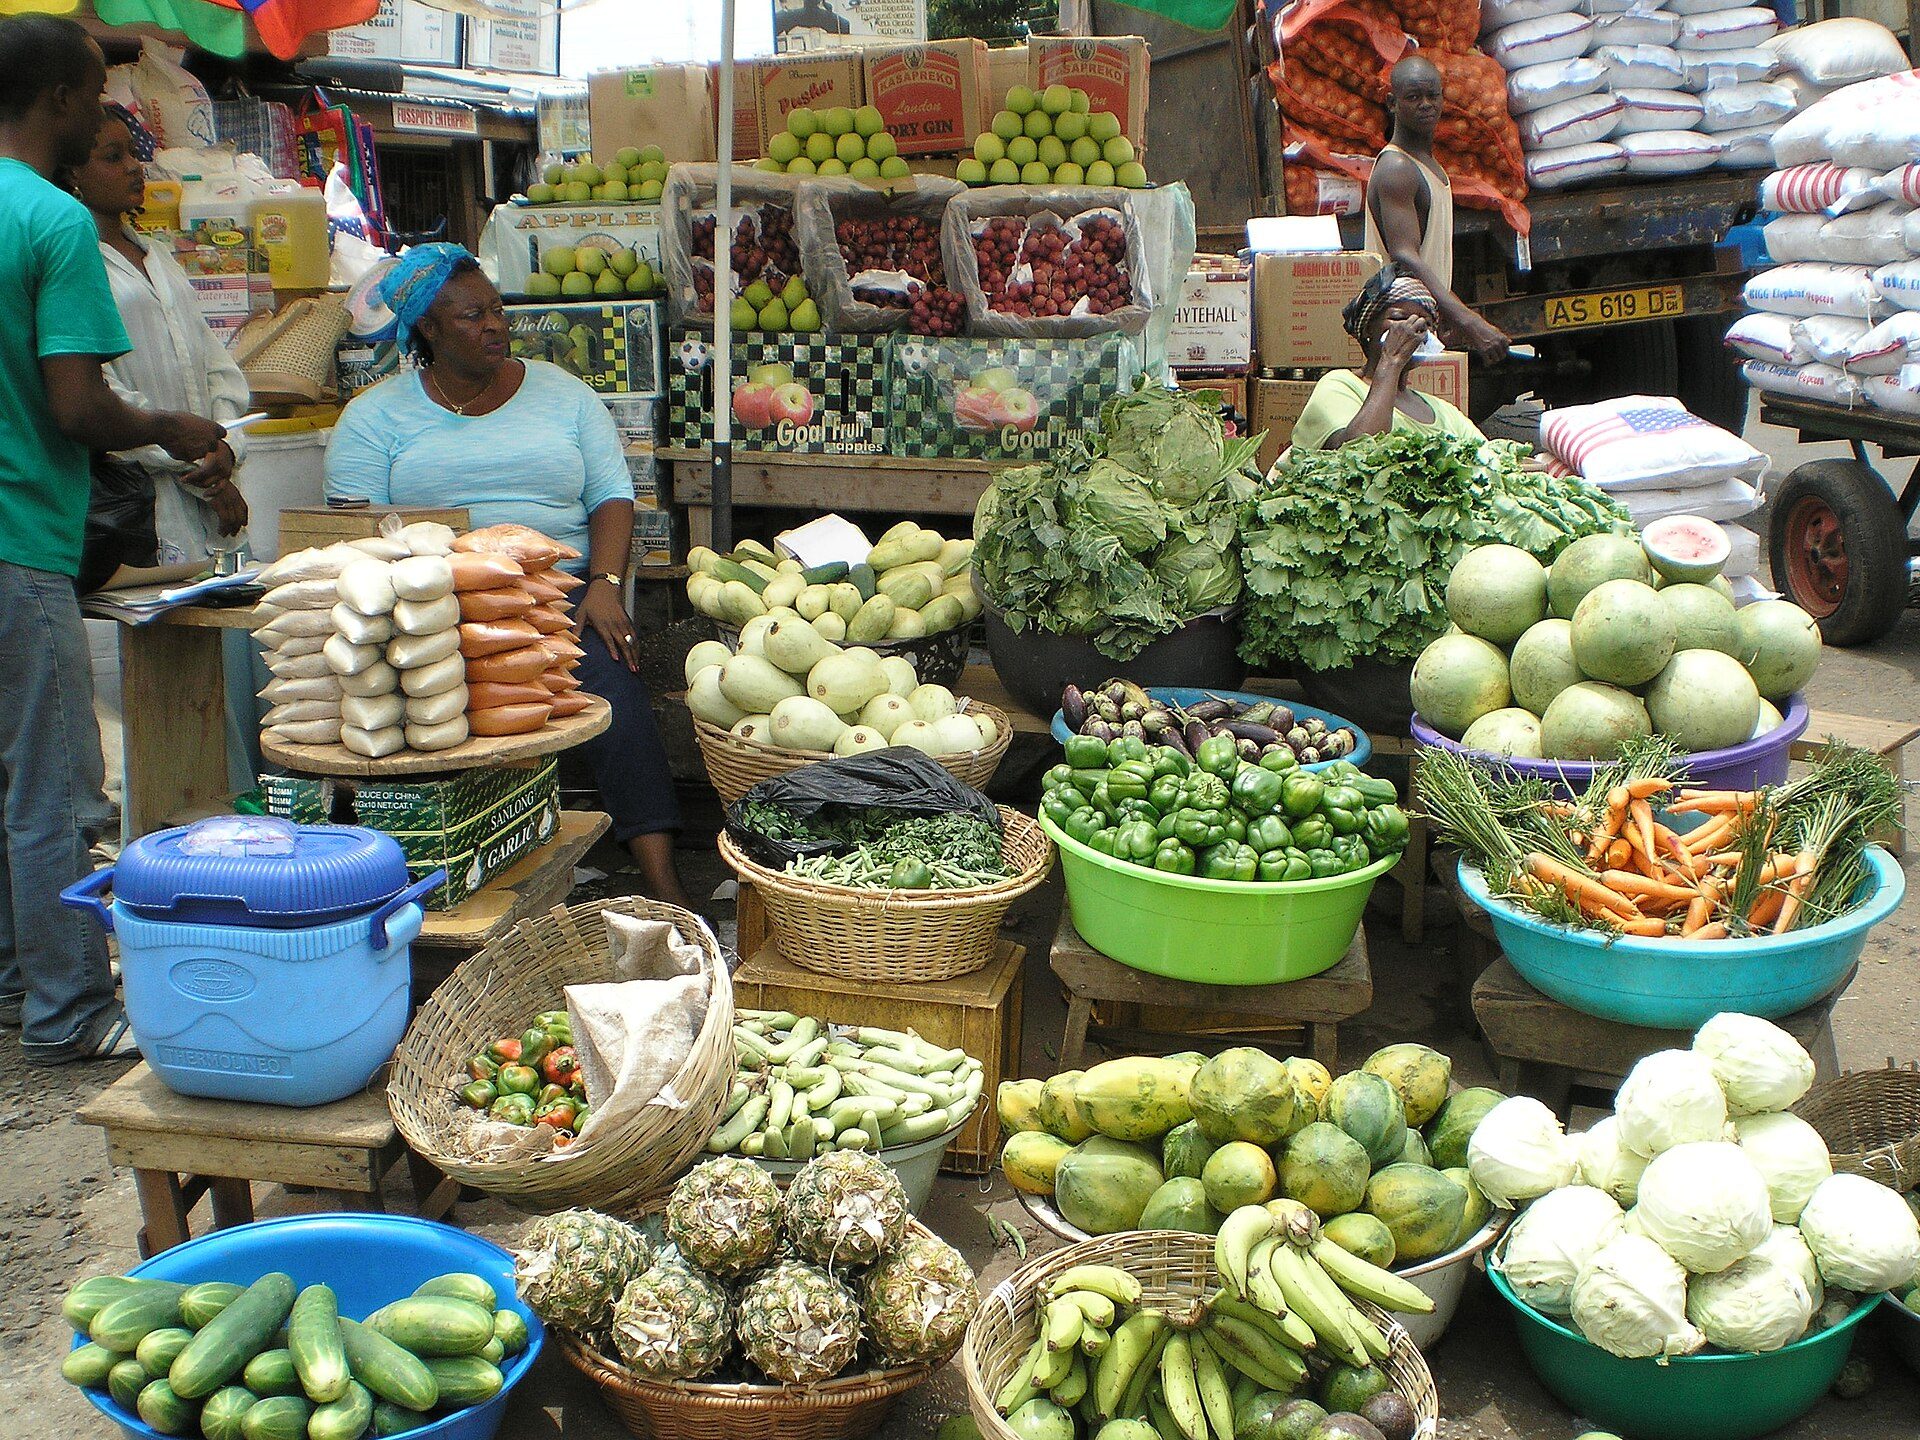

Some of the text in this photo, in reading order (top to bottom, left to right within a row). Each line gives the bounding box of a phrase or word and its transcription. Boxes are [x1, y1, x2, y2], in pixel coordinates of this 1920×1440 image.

[878, 70, 954, 91] KASAPREKO
[893, 99, 942, 116] London
[397, 106, 475, 131] FUSSPOTS ENTERPRISE
[886, 119, 954, 138] DRY GIN
[196, 291, 240, 302] Catering
[1749, 288, 1770, 300] BIGG
[1772, 288, 1805, 300] Elephant
[1172, 307, 1238, 323] HYTEHALL
[1552, 290, 1664, 325] AS 619 D
[1748, 360, 1767, 372] BIGG
[1768, 363, 1799, 378] Elephant
[776, 415, 865, 447] Goal Fruit
[1000, 421, 1051, 452] Goal
[836, 440, 884, 453] apples
[382, 791, 395, 800] OF
[395, 792, 421, 801] CHINA
[490, 790, 535, 831] SANLONG
[487, 821, 536, 870] GARLIC
